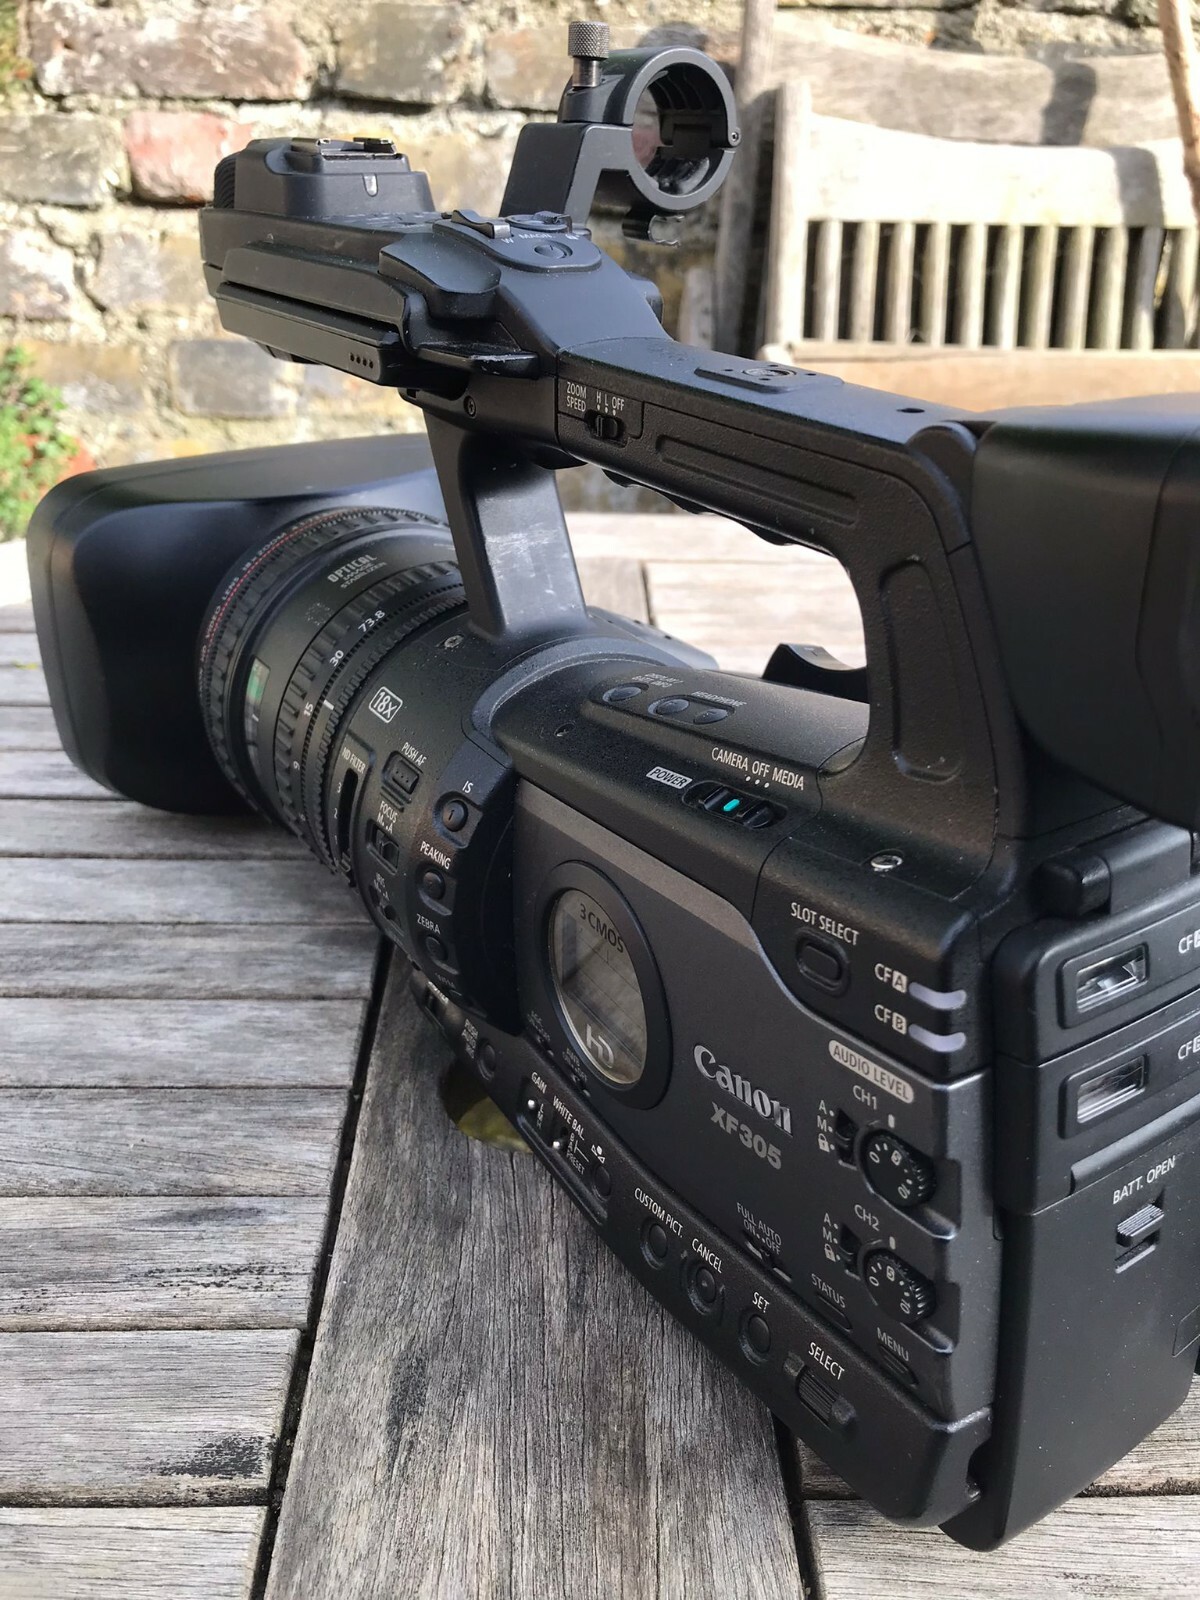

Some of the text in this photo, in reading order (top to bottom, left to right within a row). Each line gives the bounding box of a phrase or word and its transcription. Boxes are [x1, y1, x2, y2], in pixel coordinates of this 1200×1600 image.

[566, 382, 587, 399] ZOOM
[596, 392, 625, 412] H L OFF
[566, 396, 587, 412] SPEED
[327, 554, 378, 582] OPTICAL
[358, 610, 386, 633] 73.8
[330, 650, 344, 667] 30
[303, 702, 314, 718] 15
[350, 754, 366, 774] FILTER
[401, 742, 427, 766] PUSH AF
[650, 768, 688, 787] POWER
[711, 747, 804, 790] CAMERA OFF MEDIA
[462, 780, 474, 794] IS
[380, 800, 398, 824] FOCUS
[420, 841, 451, 870] PEAKING
[416, 913, 440, 934] ZEBRA
[790, 902, 860, 946] SLOT SELECT
[532, 1072, 548, 1094] GAIN
[833, 1044, 910, 1100] AUDIO LEVEL
[694, 1044, 794, 1136] Canon
[852, 1085, 878, 1110] CH1
[553, 1096, 573, 1124] WHITE
[818, 1100, 828, 1114] A
[710, 1101, 782, 1170] XF305
[817, 1115, 828, 1132] M
[566, 1150, 586, 1175] PRESET
[870, 1151, 880, 1164] 0
[1112, 1154, 1177, 1206] BATT. OPEN
[634, 1188, 684, 1238] CUSTOM PICT.
[736, 1202, 782, 1246] FULL AUTO
[824, 1212, 832, 1226] A
[854, 1204, 880, 1231] CH2
[744, 1219, 780, 1254] ON OFF
[822, 1227, 832, 1244] M
[692, 1238, 724, 1274] CANCEL
[812, 1274, 846, 1308] STATUS
[869, 1276, 880, 1287] 0
[752, 1292, 770, 1314] SET
[876, 1327, 910, 1362] MENU
[808, 1342, 845, 1380] SELECT
